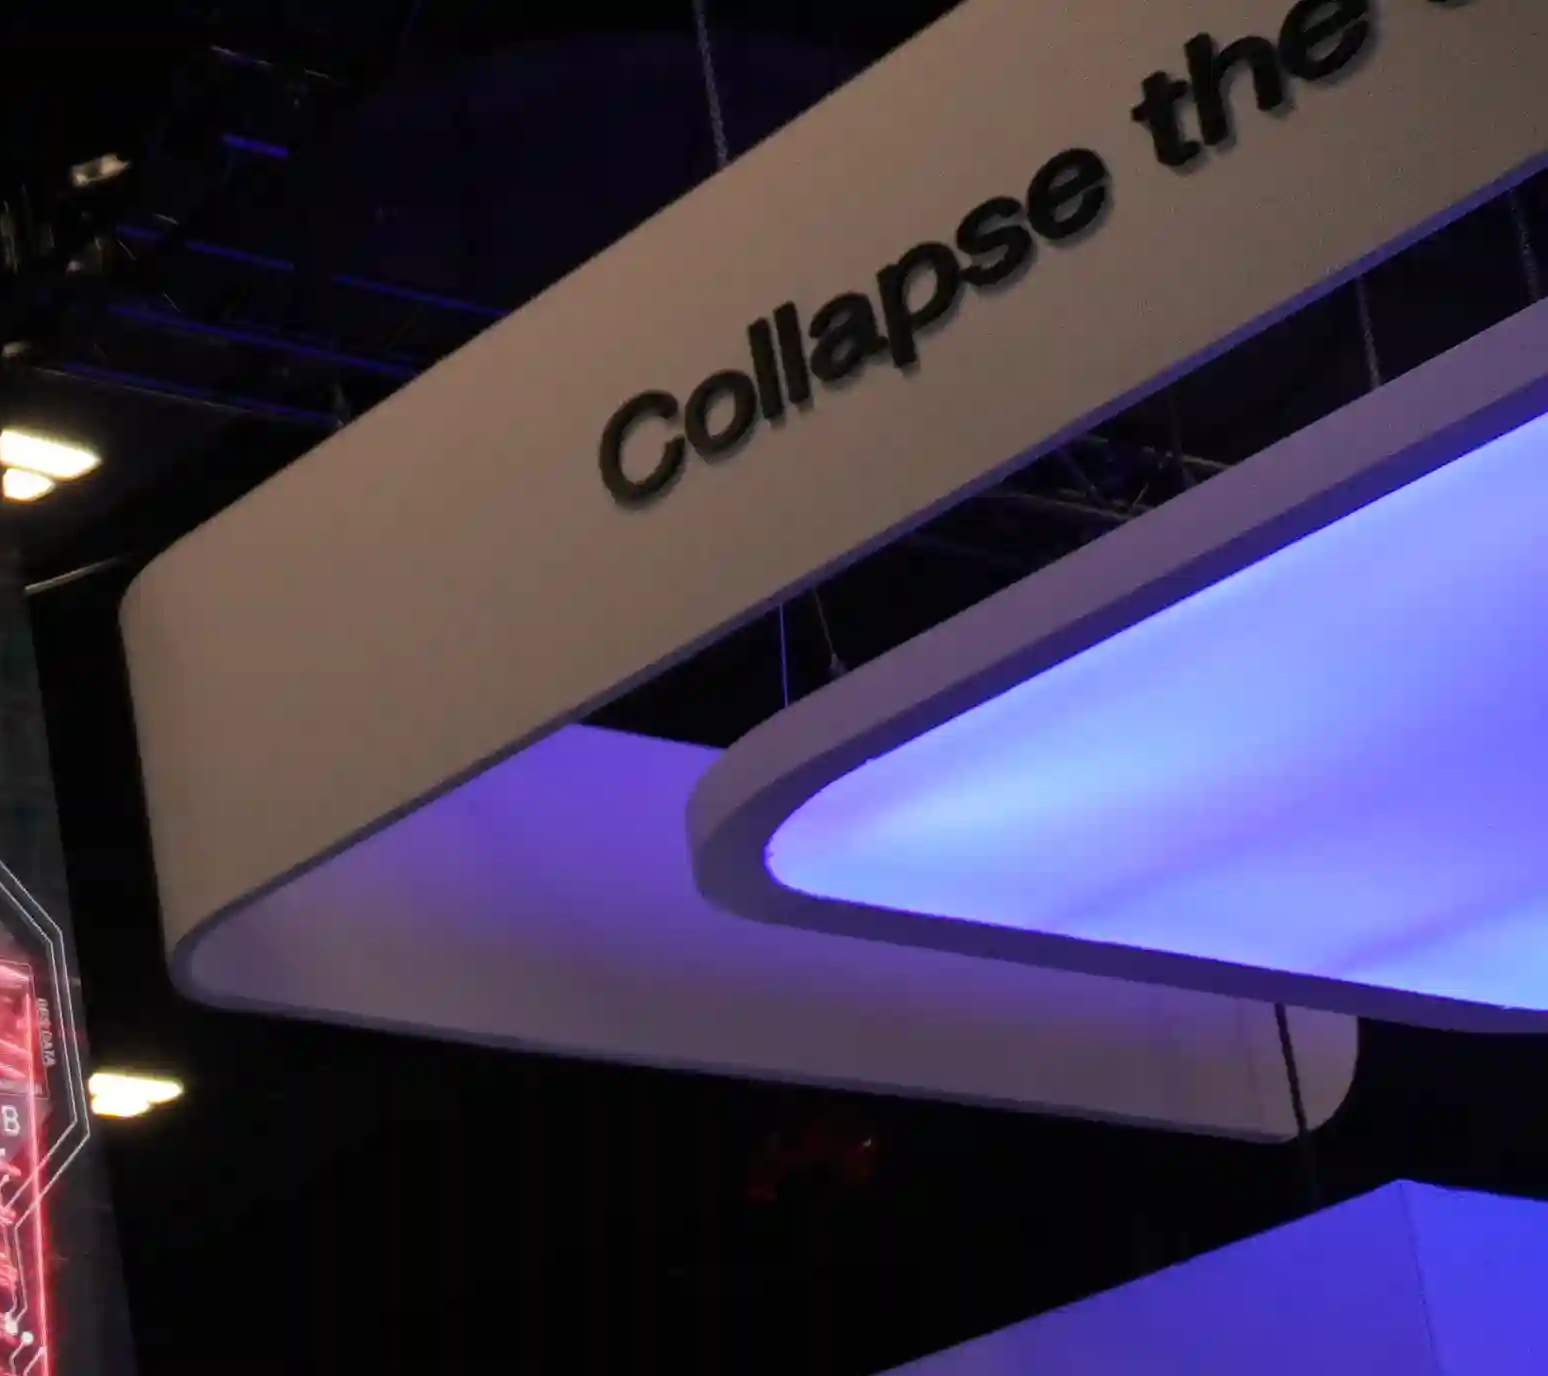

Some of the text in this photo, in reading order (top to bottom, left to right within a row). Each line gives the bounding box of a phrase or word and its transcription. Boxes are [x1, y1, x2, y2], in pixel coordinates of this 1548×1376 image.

[598, 0, 1373, 507] Collapse the
[1, 1105, 21, 1137] B
